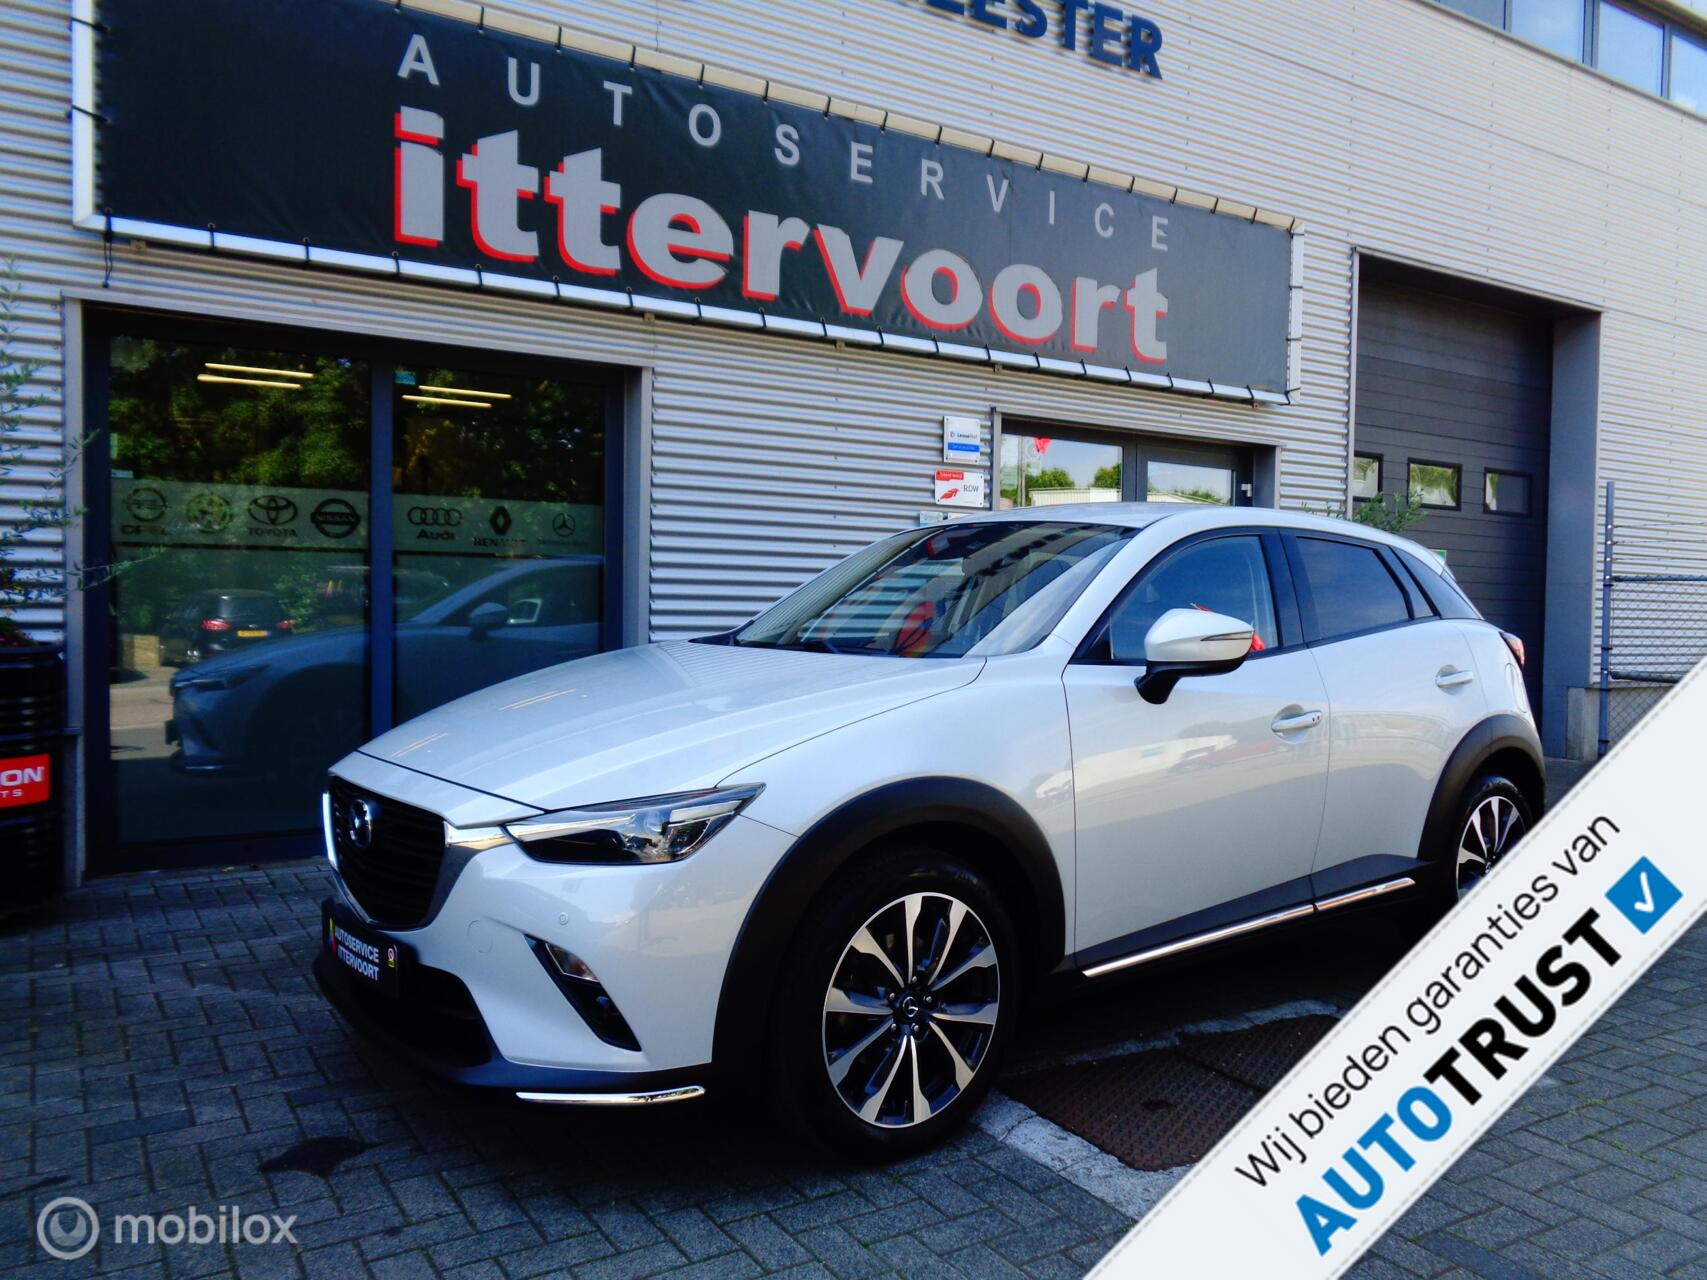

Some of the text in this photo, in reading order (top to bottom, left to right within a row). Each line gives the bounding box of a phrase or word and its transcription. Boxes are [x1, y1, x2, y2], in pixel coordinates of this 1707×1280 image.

[923, 0, 1163, 80] ESTER
[398, 34, 1169, 252] AUTOSERVICE
[394, 105, 1169, 364] ittervoort
[963, 484, 980, 493] RDW
[247, 527, 299, 537] TOYOTA
[416, 528, 456, 541] Audi
[335, 925, 379, 963] AUTOSERVICE
[338, 945, 379, 981] ITTERVOORT
